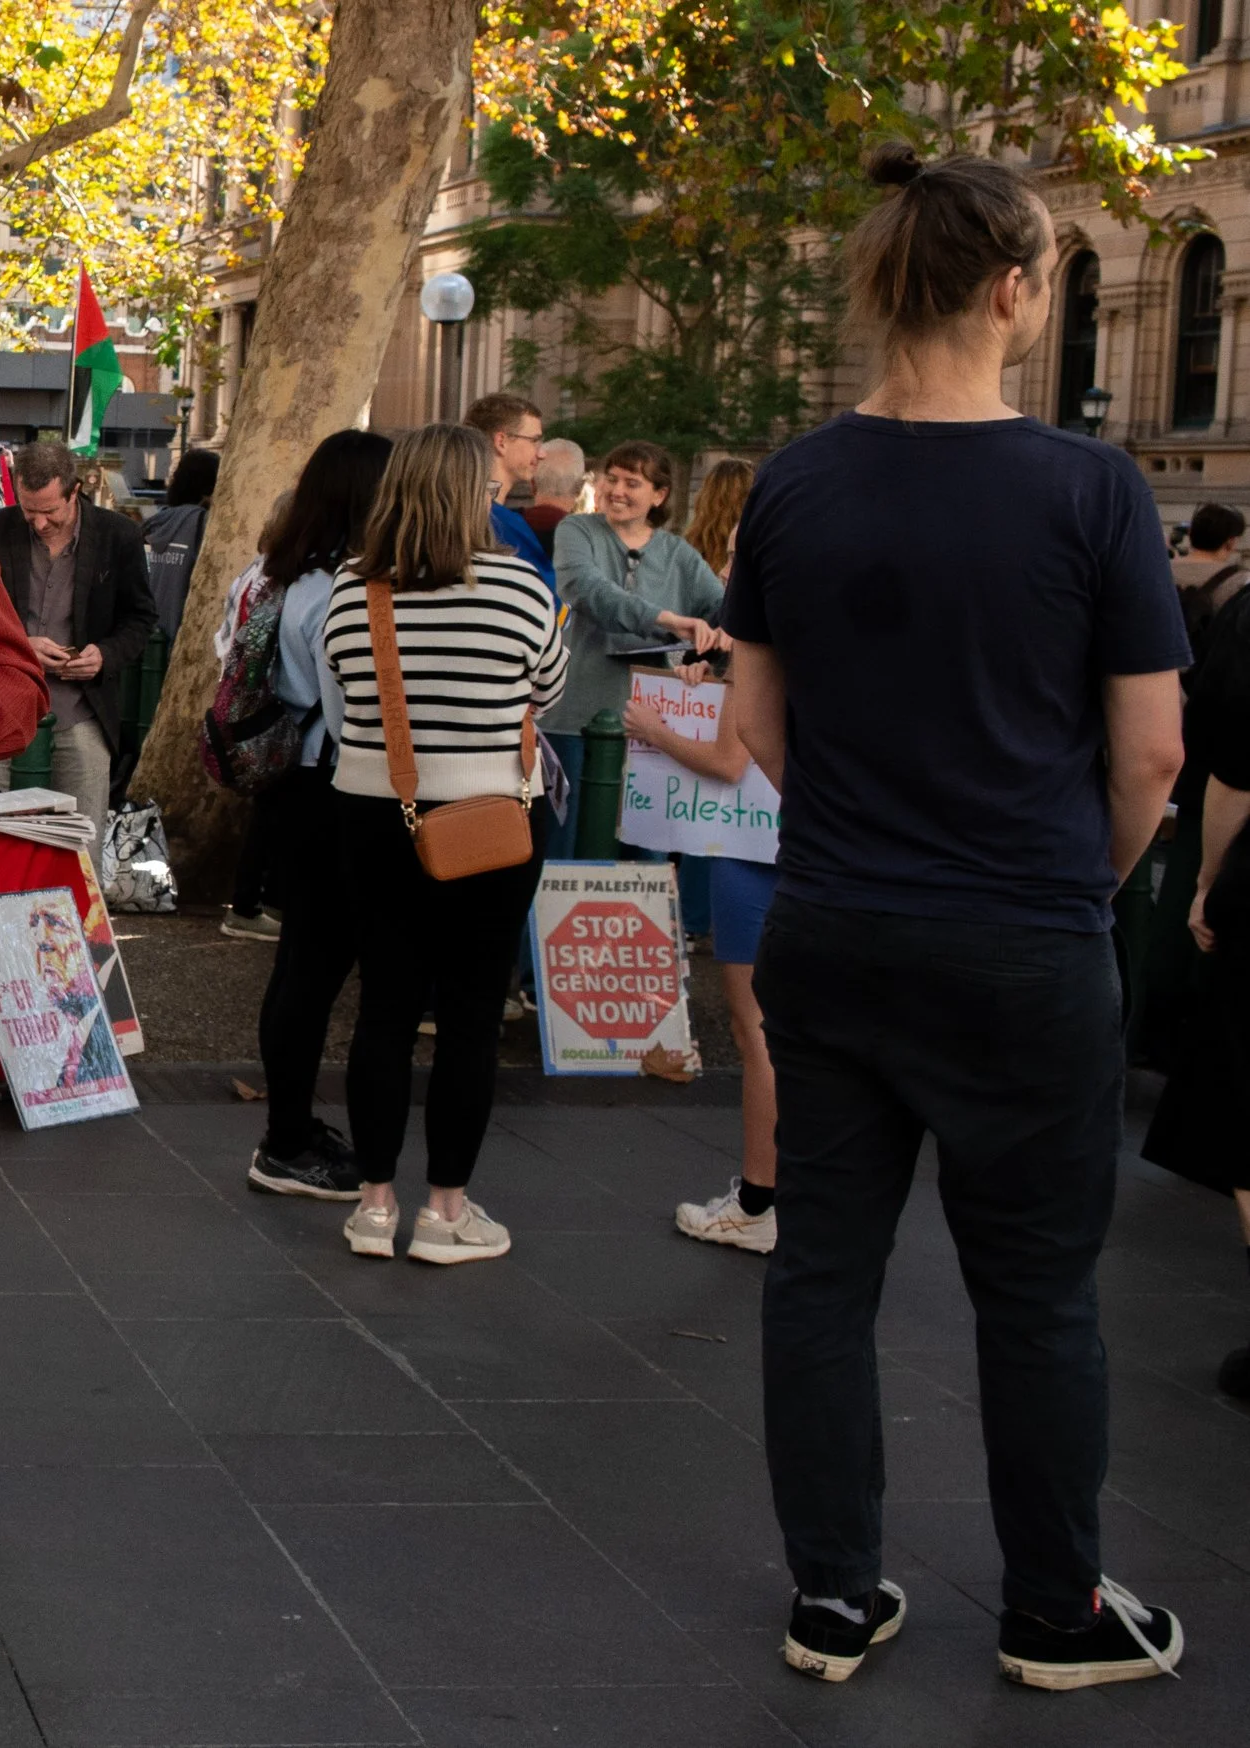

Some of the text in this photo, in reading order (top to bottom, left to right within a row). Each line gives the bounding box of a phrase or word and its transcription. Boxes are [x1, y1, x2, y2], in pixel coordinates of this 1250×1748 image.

[624, 773, 654, 811] Free
[541, 879, 667, 893] FREE PALESTINE
[572, 915, 644, 939] STOP
[549, 945, 673, 969] ISRAEL'S
[551, 973, 676, 994] GENOCIDE
[575, 1001, 659, 1024] NOW!
